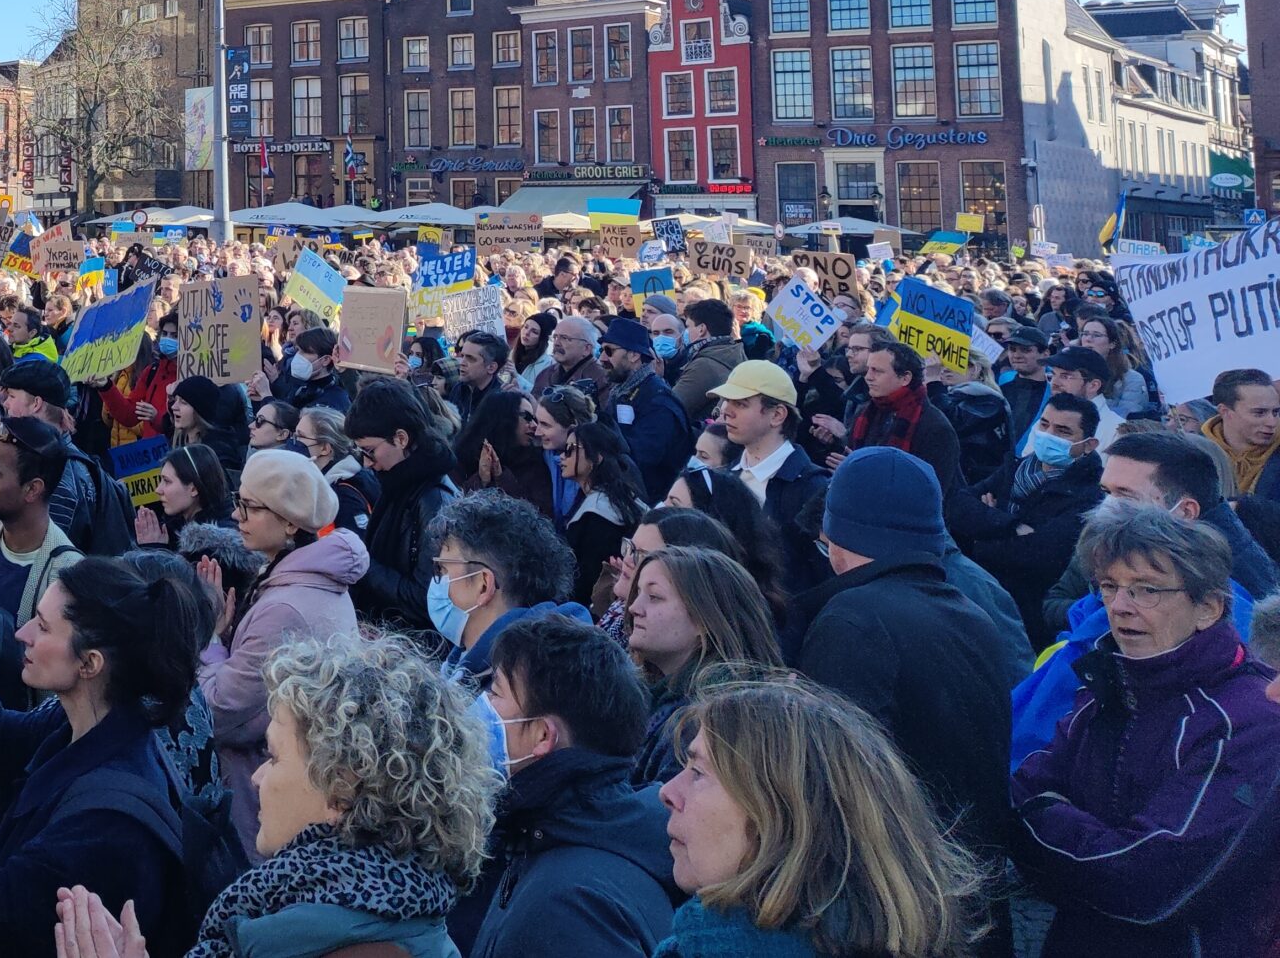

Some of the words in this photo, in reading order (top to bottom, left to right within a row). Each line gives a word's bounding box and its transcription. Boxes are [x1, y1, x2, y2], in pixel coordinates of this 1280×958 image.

[767, 136, 821, 146] Heineken
[827, 128, 876, 146] Drie
[886, 126, 989, 150] Gezusters
[284, 142, 331, 152] DOELEN
[531, 170, 567, 178] Heineken
[574, 166, 615, 179] GROOTE
[615, 165, 644, 178] GRIET
[476, 223, 505, 231] RUSSIAN
[507, 223, 542, 231] WARSHIP
[655, 222, 681, 238] RICH
[478, 236, 493, 246] GO
[513, 235, 544, 244] YOURSELF
[746, 238, 764, 248] FUCK
[712, 244, 737, 258] NO
[1119, 241, 1159, 255] СЛАВА
[144, 257, 160, 270] NO
[813, 256, 852, 280] NO
[790, 284, 835, 327] STOP
[905, 289, 928, 315] NO
[774, 305, 813, 349] WAR
[207, 323, 229, 350] OFF
[898, 323, 924, 349] НЕТ
[926, 332, 969, 370] ВОЙНЕ
